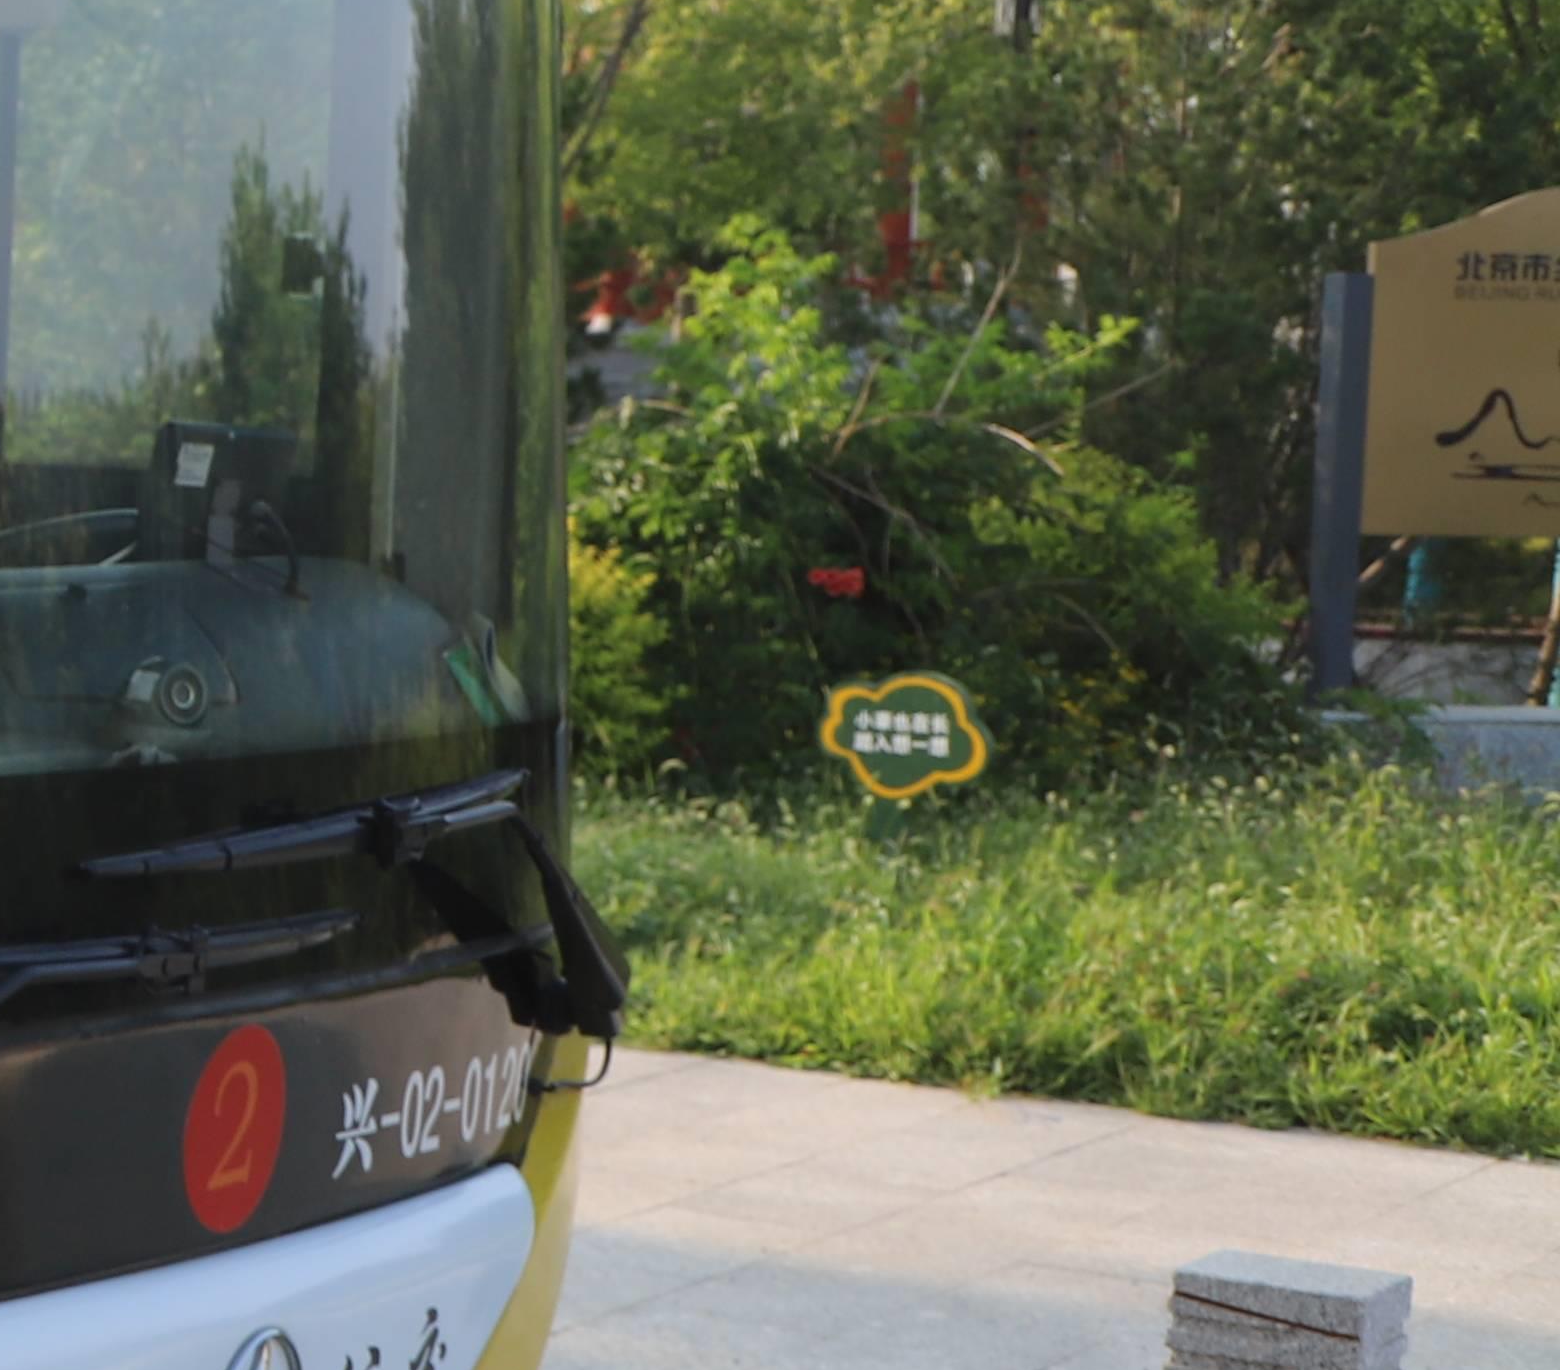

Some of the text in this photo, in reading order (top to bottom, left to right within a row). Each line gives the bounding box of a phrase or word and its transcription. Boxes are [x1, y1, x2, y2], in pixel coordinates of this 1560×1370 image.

[1456, 251, 1560, 281] 北京市
[207, 1061, 259, 1190] 2
